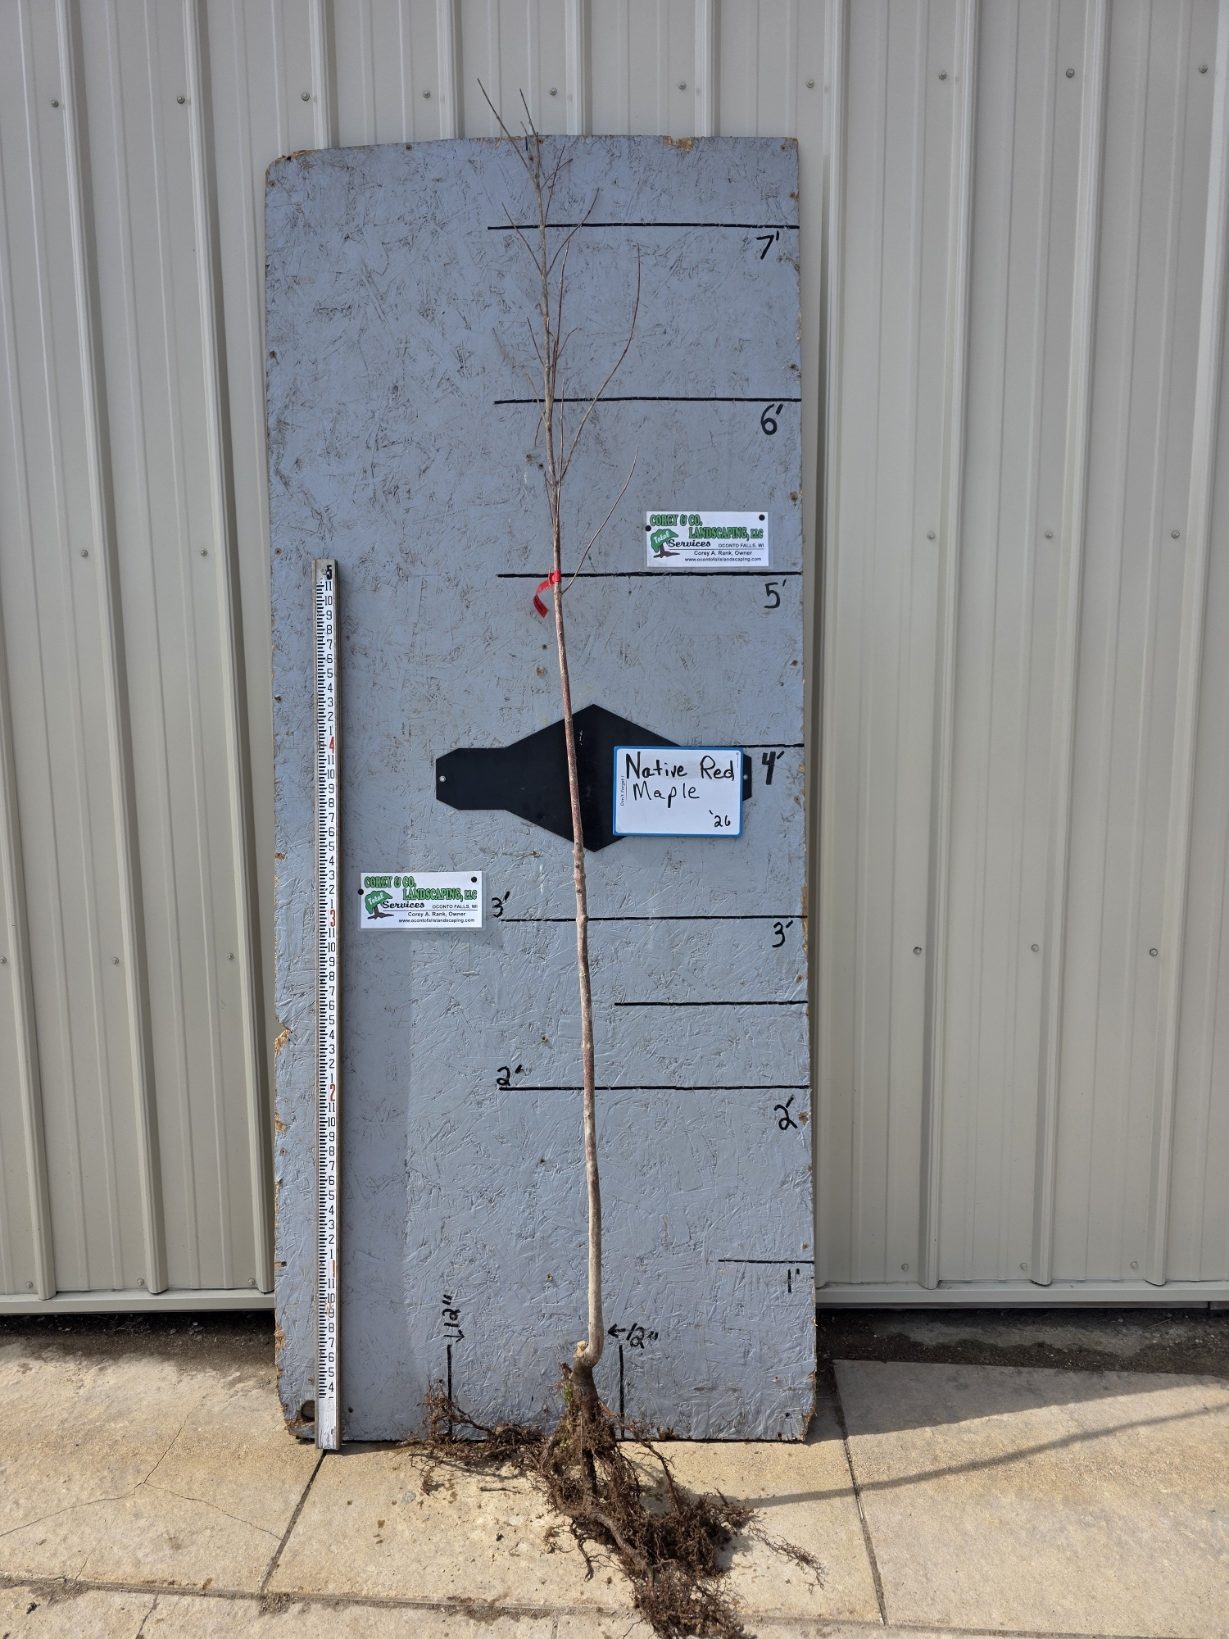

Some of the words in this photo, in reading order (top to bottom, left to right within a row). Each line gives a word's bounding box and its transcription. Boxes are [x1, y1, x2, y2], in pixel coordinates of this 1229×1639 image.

[756, 231, 780, 260] 7'
[760, 403, 784, 436] 6'
[650, 514, 679, 526] COREY
[679, 514, 688, 526] &
[688, 514, 703, 526] CO.
[654, 530, 670, 543] Total
[688, 527, 749, 541] LANDSCAPING,
[668, 539, 711, 548] Services
[326, 565, 332, 580] 5
[325, 581, 332, 591] 11
[764, 579, 787, 609] 5'
[325, 596, 332, 606] 10
[326, 610, 332, 620] 9
[326, 625, 333, 635] 8
[327, 639, 333, 649] 7
[327, 654, 333, 664] 6
[327, 668, 333, 678] 5
[327, 683, 333, 693] 4
[327, 697, 334, 707] 3
[327, 711, 334, 721] 2
[329, 736, 335, 753] 4
[327, 755, 334, 765] 11
[625, 751, 687, 780] Native
[700, 755, 735, 781] Red
[761, 751, 785, 785] 4'
[327, 769, 334, 779] 10
[328, 783, 335, 793] 9
[632, 780, 700, 808] Maple
[328, 798, 335, 808] 8
[328, 812, 335, 822] 7
[328, 827, 335, 837] 6
[328, 841, 335, 851] 5
[328, 856, 335, 865] 4
[328, 870, 335, 880] 3
[364, 876, 392, 888] COREY
[393, 876, 401, 888] &
[402, 876, 416, 888] CO.
[328, 885, 335, 894] 2
[367, 892, 383, 905] Total
[402, 888, 463, 902] LANDSCAPING,
[382, 901, 425, 909] Services
[491, 891, 510, 918] 3'
[330, 910, 335, 927] 3
[328, 928, 335, 938] 11
[772, 920, 793, 948] 3'
[328, 942, 335, 952] 10
[328, 957, 335, 967] 9
[328, 971, 335, 981] 8
[328, 986, 335, 996] 7
[328, 1000, 335, 1010] 6
[328, 1015, 335, 1025] 5
[328, 1030, 335, 1039] 4
[328, 1044, 335, 1054] 3
[328, 1059, 335, 1069] 2
[330, 1084, 335, 1102] 2
[328, 1103, 335, 1112] 11
[328, 1117, 335, 1127] 10
[328, 1131, 335, 1141] 9
[328, 1146, 335, 1156] 8
[328, 1160, 335, 1170] 7
[328, 1175, 335, 1185] 6
[328, 1190, 335, 1200] 5
[328, 1205, 334, 1215] 4
[328, 1219, 335, 1229] 3
[328, 1234, 335, 1244] 2
[328, 1278, 334, 1288] 11
[327, 1293, 335, 1303] 10
[328, 1322, 334, 1332] 8
[328, 1337, 334, 1347] 7
[328, 1352, 334, 1362] 6
[328, 1367, 334, 1377] 5
[328, 1382, 334, 1392] 4
